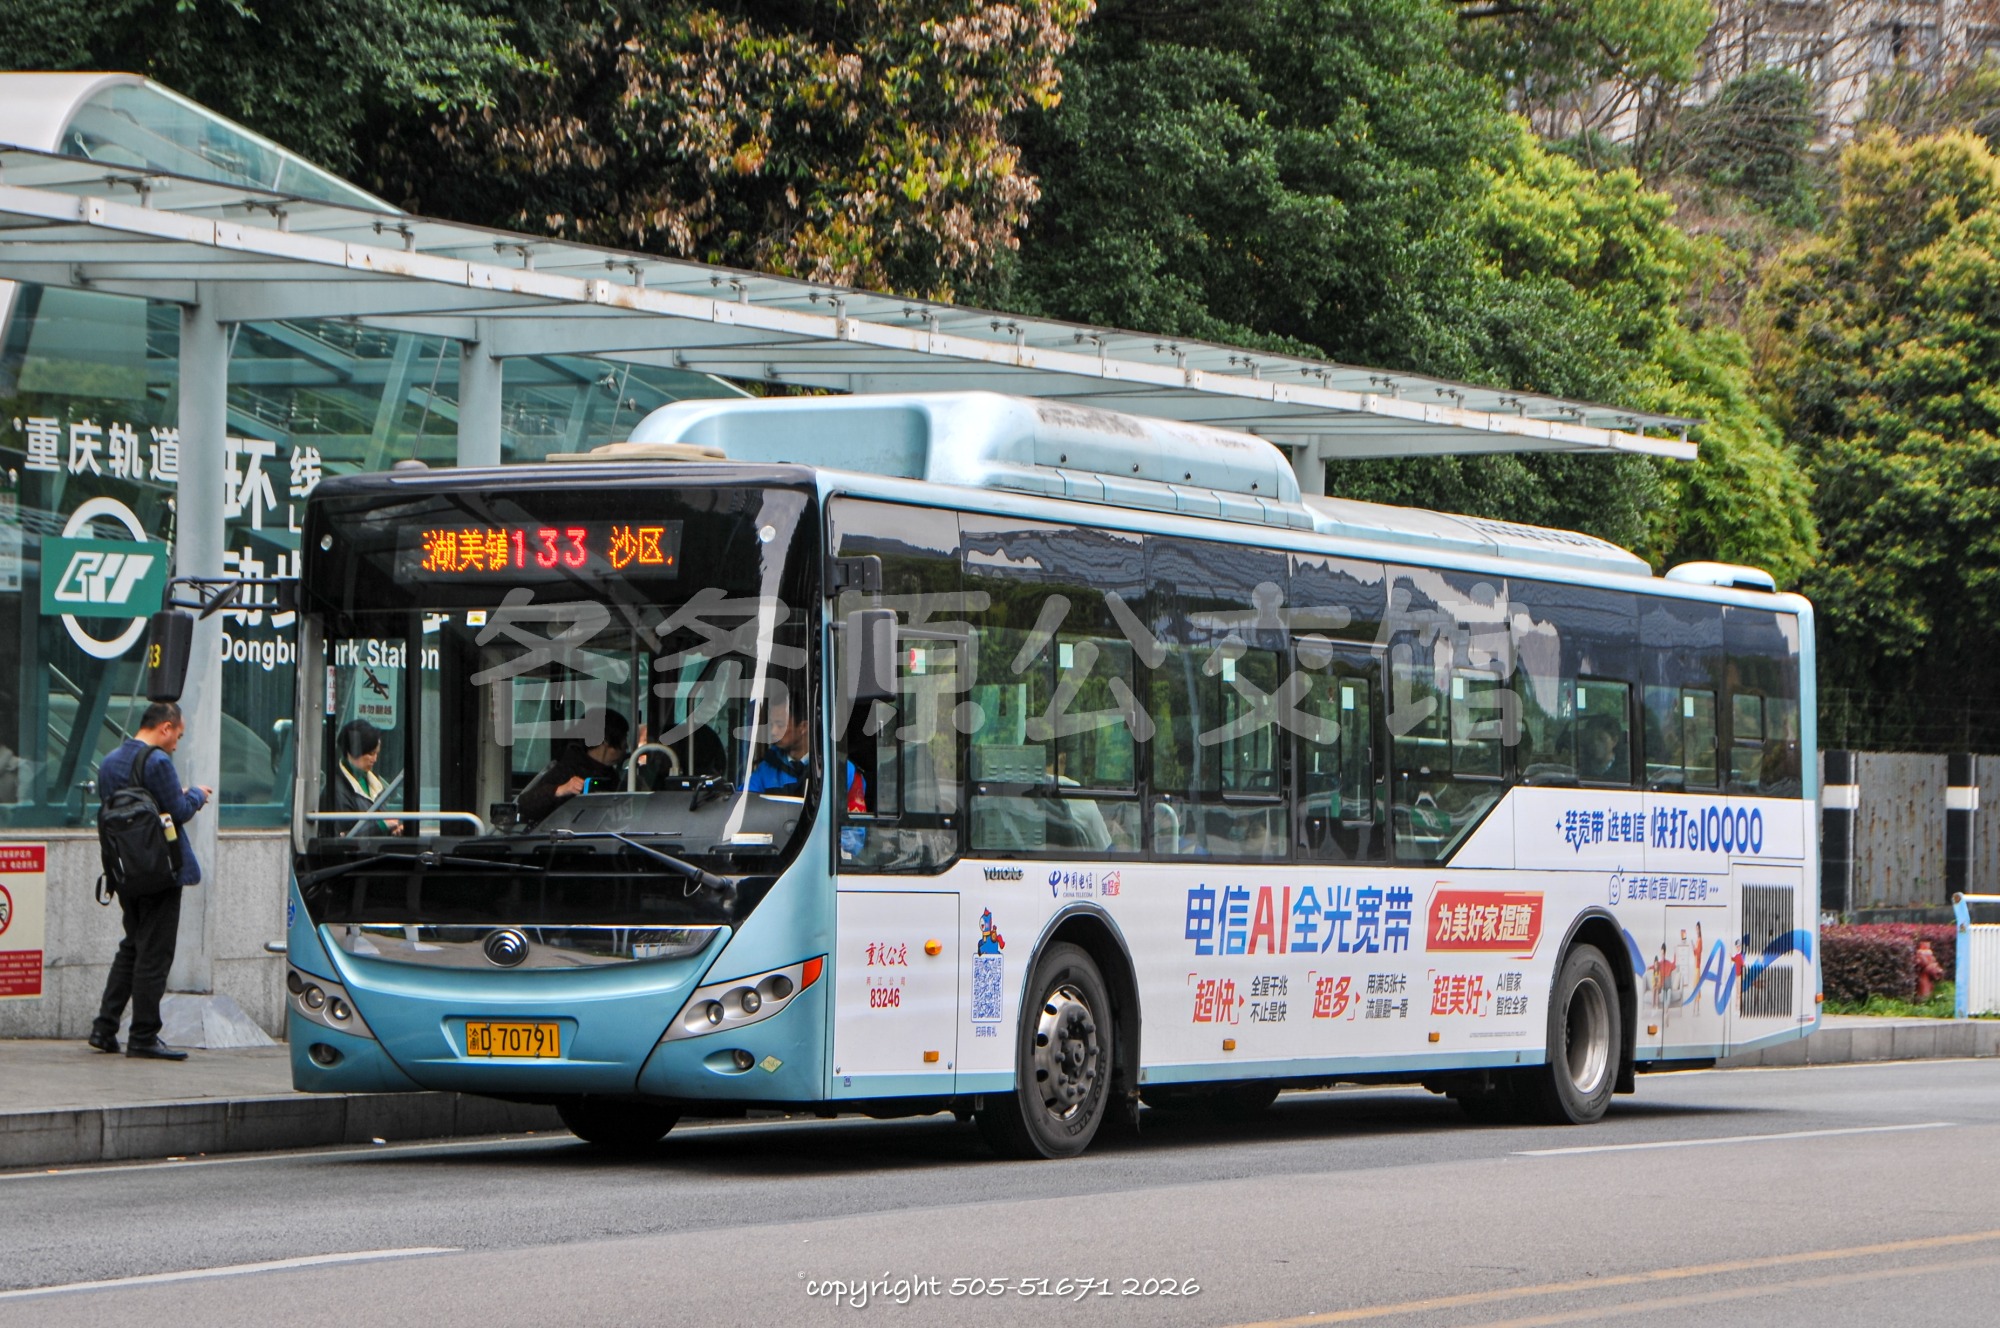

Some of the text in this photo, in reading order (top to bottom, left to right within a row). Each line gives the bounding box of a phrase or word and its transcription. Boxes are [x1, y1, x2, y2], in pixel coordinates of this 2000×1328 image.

[24, 416, 180, 483] 重庆轨道
[511, 529, 587, 568] 133
[367, 638, 440, 670] Staton
[1062, 871, 1093, 891] 中国电信
[1184, 883, 1414, 957] 电信AI全光宽带
[1434, 903, 1535, 943] 为美好家提速
[865, 942, 908, 967] 重庆公交
[870, 987, 900, 1008] 83246
[1192, 975, 1237, 1023] 超快
[1312, 976, 1352, 1019] 超多
[1366, 973, 1407, 994] 用满5张卡
[1430, 974, 1484, 1016] 超美好
[1249, 1000, 1288, 1024] 不止是快
[1496, 995, 1529, 1016] 智控全家
